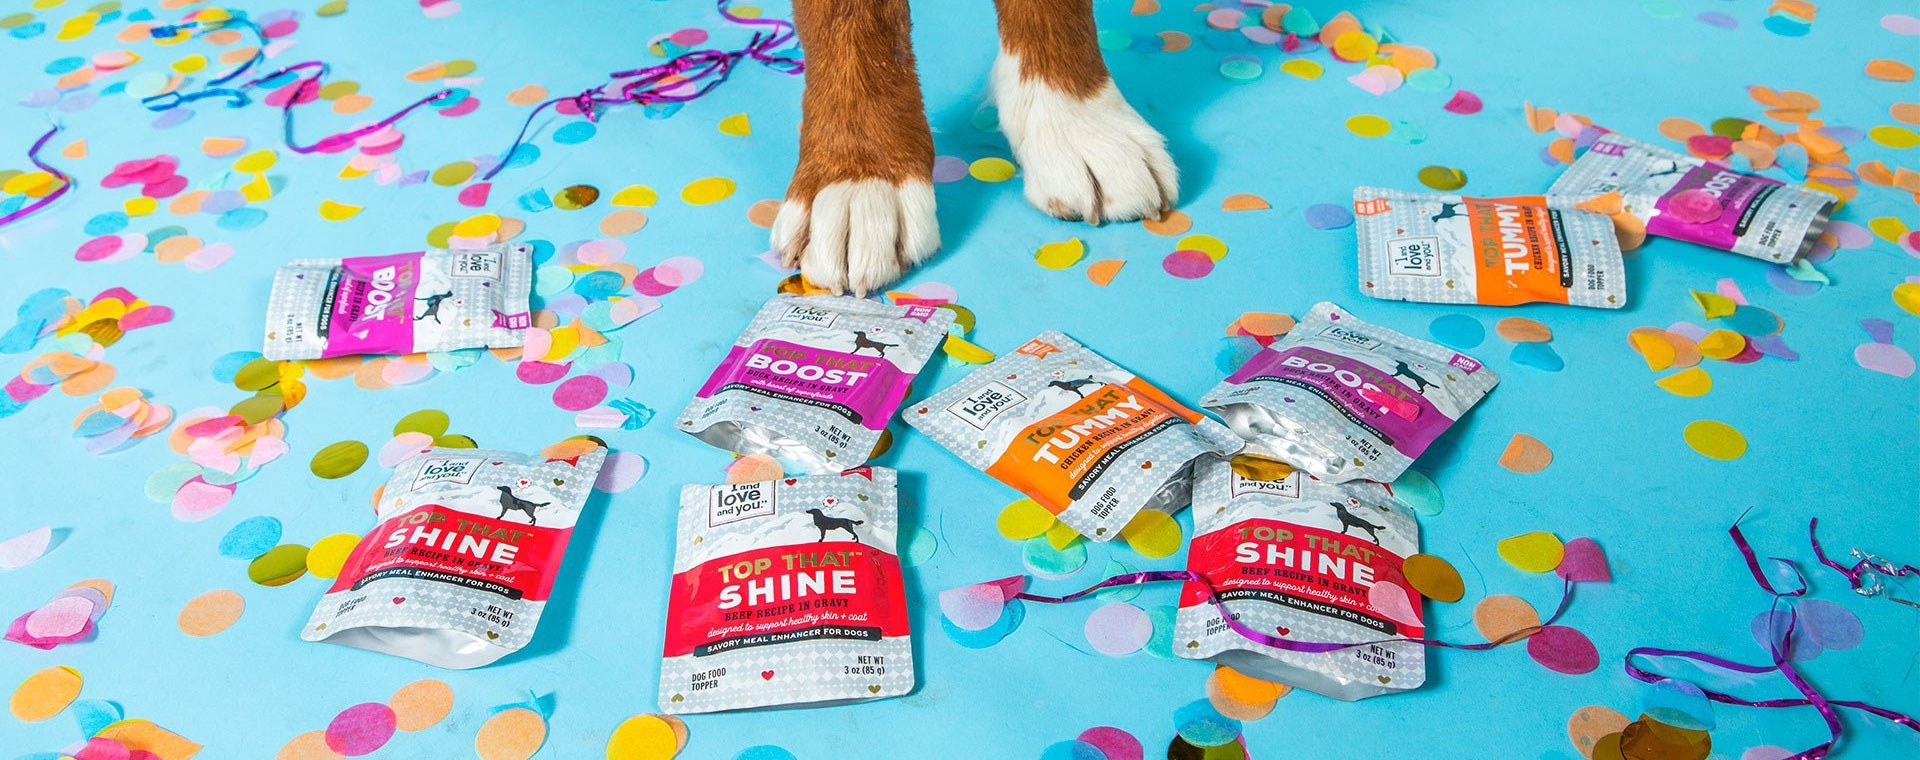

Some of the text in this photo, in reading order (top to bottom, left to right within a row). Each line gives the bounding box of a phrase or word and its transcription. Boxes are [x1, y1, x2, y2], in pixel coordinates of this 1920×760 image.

[1494, 203, 1530, 276] TUMMY
[470, 254, 488, 271] love
[1404, 244, 1422, 270] love
[1482, 238, 1500, 268] TOP
[1531, 244, 1543, 270] CHICKEN
[1561, 257, 1570, 278] SAVORY
[362, 266, 396, 320] BOOST
[320, 315, 329, 331] DOGS
[762, 344, 806, 360] TOP
[1298, 350, 1344, 365] TOP
[1457, 357, 1476, 368] NON
[746, 354, 868, 386] BOOST
[747, 370, 849, 394] DUCK RECIPE IN GRAVY
[766, 380, 834, 400] boost superfoods
[751, 387, 772, 396] MEAL
[772, 393, 812, 406] ENHANCER
[815, 400, 831, 408] FOR
[832, 404, 852, 416] DOGS
[963, 392, 1002, 416] love
[979, 388, 994, 400] and
[1070, 390, 1120, 417] HAT
[1309, 370, 1342, 390] RECIPE
[1342, 388, 1352, 400] IN
[1353, 398, 1381, 420] GRAVY
[978, 409, 992, 420] and
[1286, 378, 1384, 438] MEAL ENHANCER FOR DOGS
[820, 430, 840, 444] oz (85
[830, 424, 852, 442] NET WT
[1032, 394, 1144, 465] TUMMY
[1060, 408, 1156, 470] CHICKEN RECIPE IN GRAVY
[1078, 424, 1166, 490] SAVORY MEAL ENHANCER FOR
[1360, 438, 1382, 458] NET WT
[424, 465, 466, 476] love
[1068, 454, 1095, 480] designed
[740, 482, 760, 491] and
[1240, 481, 1257, 489] and
[718, 490, 760, 508] love
[1091, 486, 1117, 516] DOG FOOD
[1098, 498, 1120, 520] TOPPER
[398, 512, 446, 528] TOP
[717, 506, 734, 516] and
[384, 526, 520, 565] SHINE
[1238, 526, 1294, 542] TOP
[384, 547, 503, 572] BEEF RECIPE IN GRAVY
[405, 558, 437, 568] support
[437, 562, 468, 575] healthy
[468, 566, 487, 576] skin
[496, 573, 516, 584] coat
[718, 558, 772, 584] TOP
[1234, 542, 1376, 588] SHINE
[360, 568, 510, 594] SAVORY MEAL ENHANCER FOR DOGS
[718, 570, 856, 610] SHINE
[1223, 576, 1358, 606] designed to support healthy skin
[1242, 566, 1368, 597] BEEF RECIPE IN GRAVY
[470, 608, 500, 624] 3 oz (85
[488, 604, 514, 620] NET WT
[725, 599, 849, 622] BEEF RECIPE IN GRAVY
[1221, 590, 1385, 629] SAVORY MEAL ENHANCER FOR DOGS
[707, 610, 868, 638] designed to support healthy skin coat
[1206, 618, 1220, 628] DOG
[706, 628, 868, 654] SAVORY MEAL ENHANCER FOR DOGS
[1370, 644, 1396, 660] NET WT
[858, 656, 884, 664] NET WT
[1356, 650, 1386, 666] 3 oz (85
[692, 668, 726, 682] DOG FOOD
[844, 666, 885, 676] 3 oz (85 g)
[692, 680, 718, 691] TOPPER
